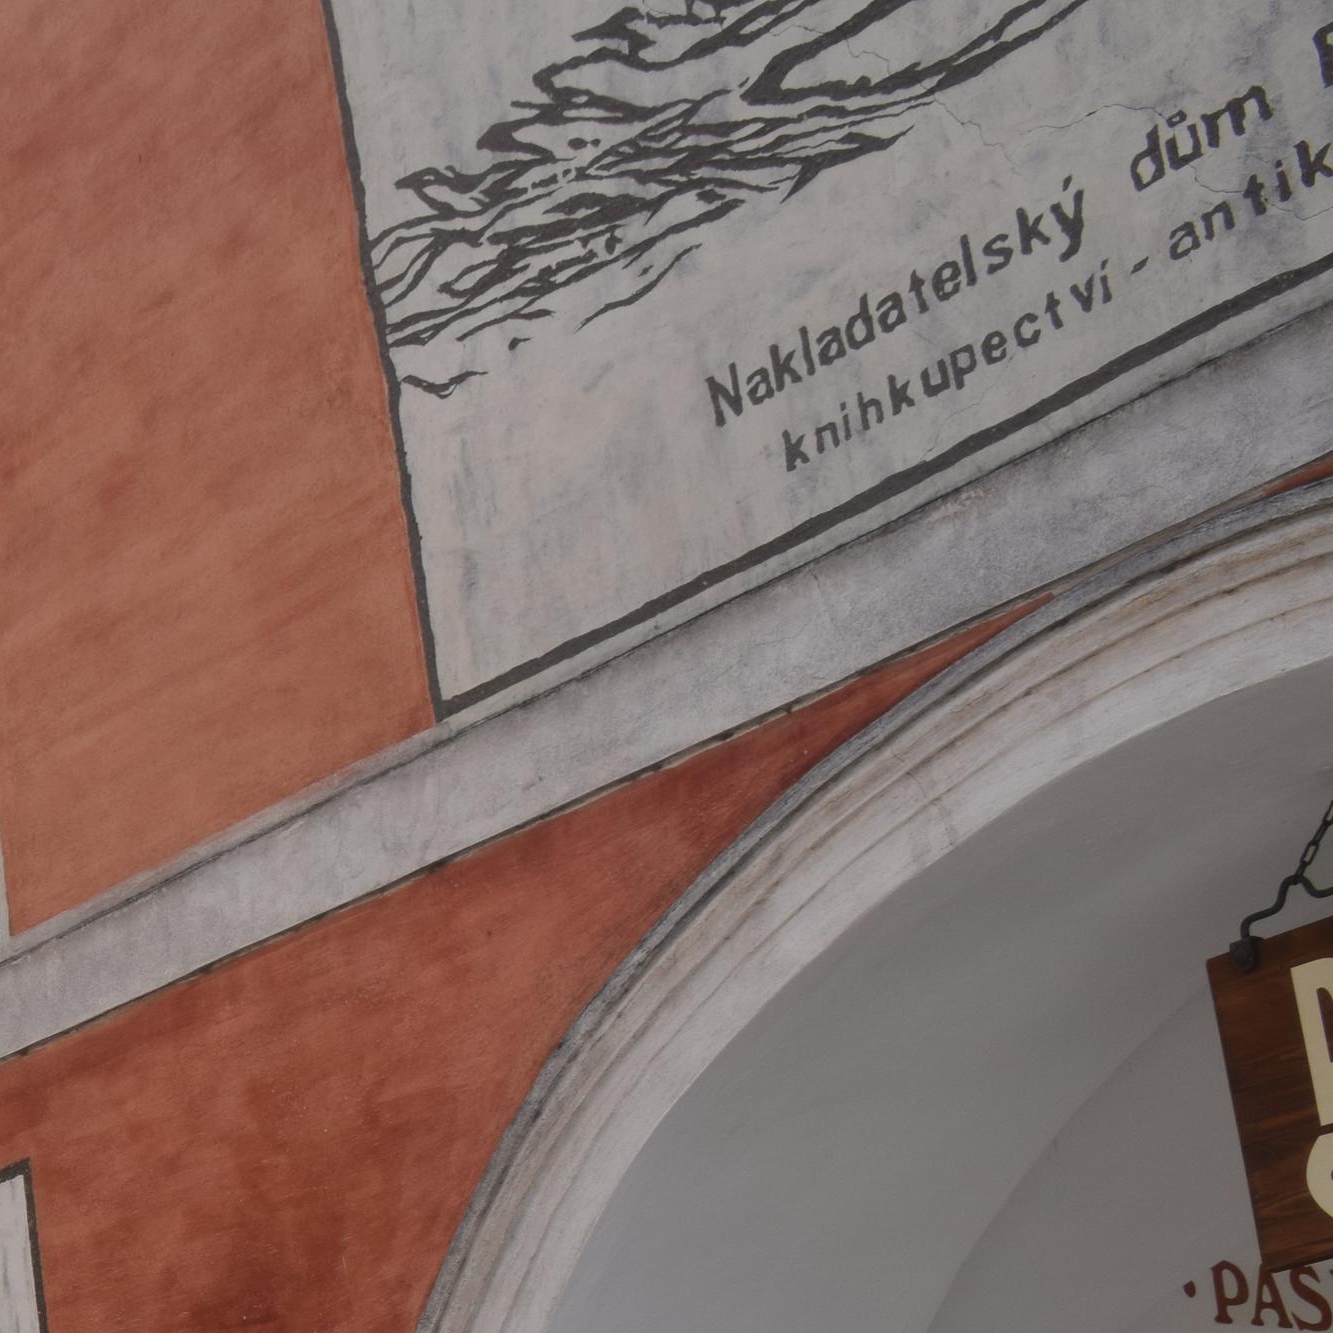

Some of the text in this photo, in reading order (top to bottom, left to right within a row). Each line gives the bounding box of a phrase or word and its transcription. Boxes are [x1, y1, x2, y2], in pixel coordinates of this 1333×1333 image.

[705, 84, 1273, 428] Nakladatelský dům
[781, 259, 1114, 472] knihkupectví
[1211, 1259, 1333, 1332] PAS
